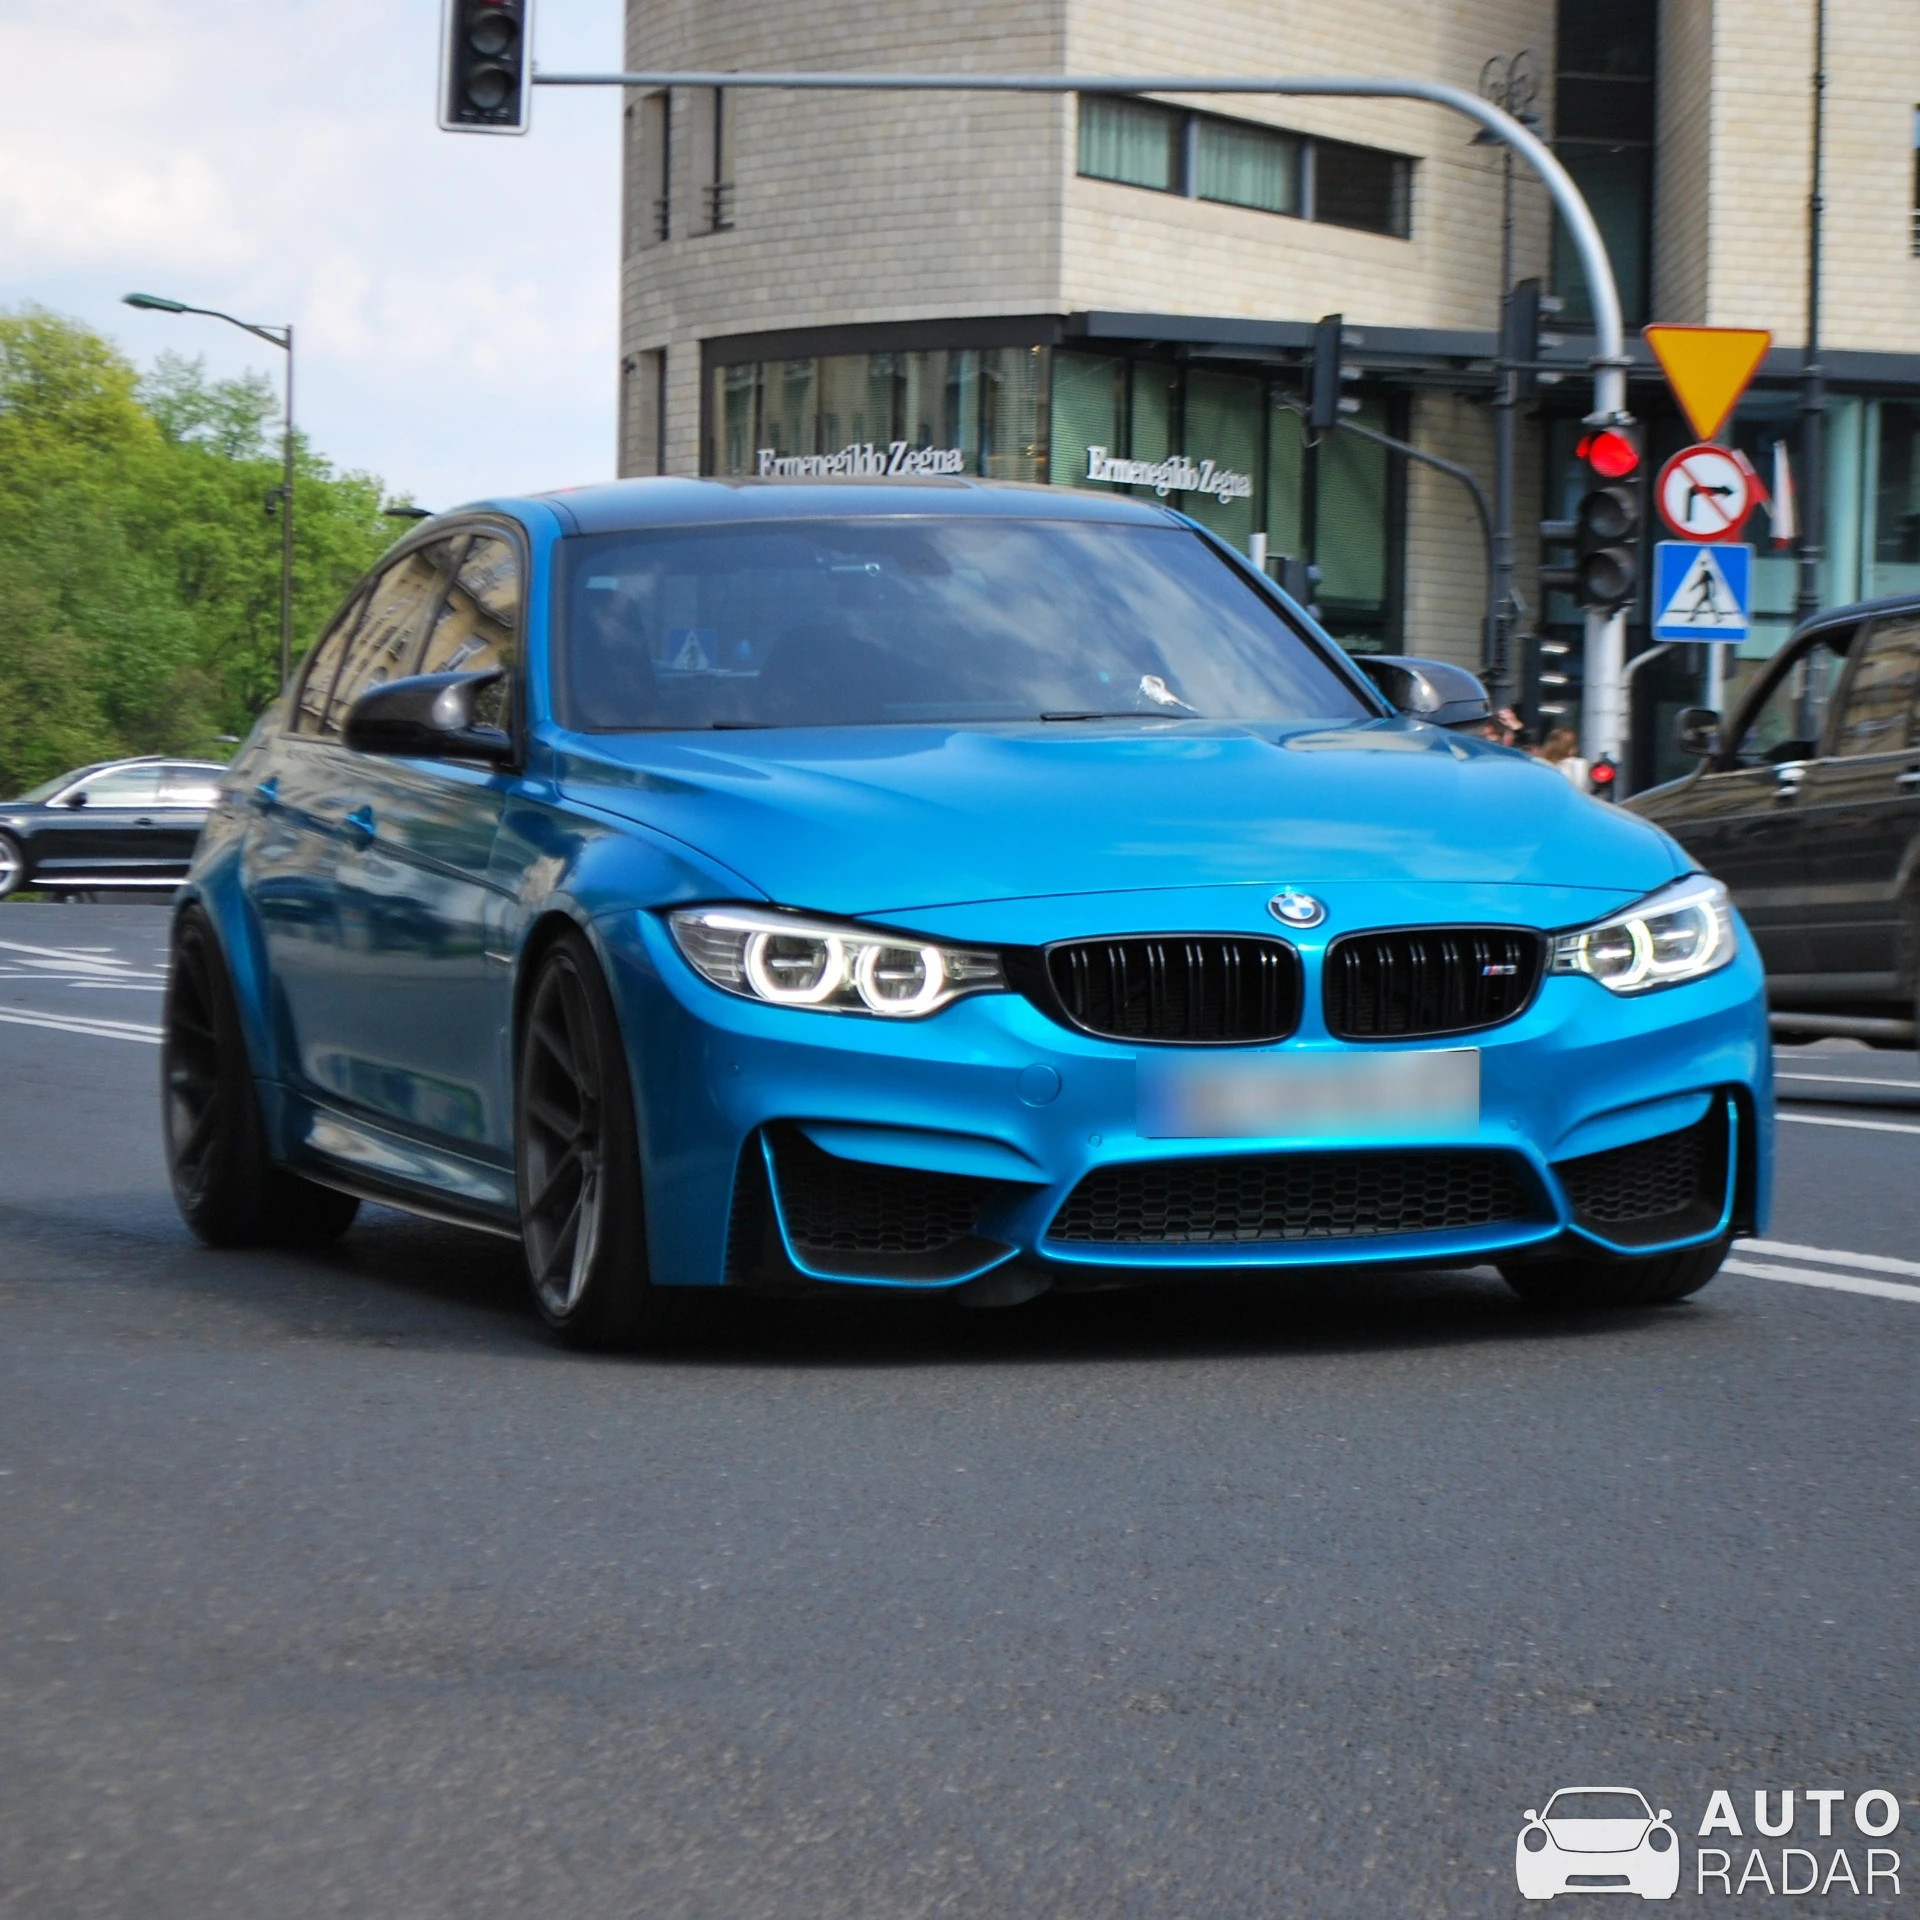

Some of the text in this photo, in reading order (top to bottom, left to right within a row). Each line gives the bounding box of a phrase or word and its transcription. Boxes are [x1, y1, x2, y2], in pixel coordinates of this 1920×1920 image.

[757, 440, 965, 476] Ermenegildo Zegna
[1086, 445, 1253, 504] Ermenegildo Zegna
